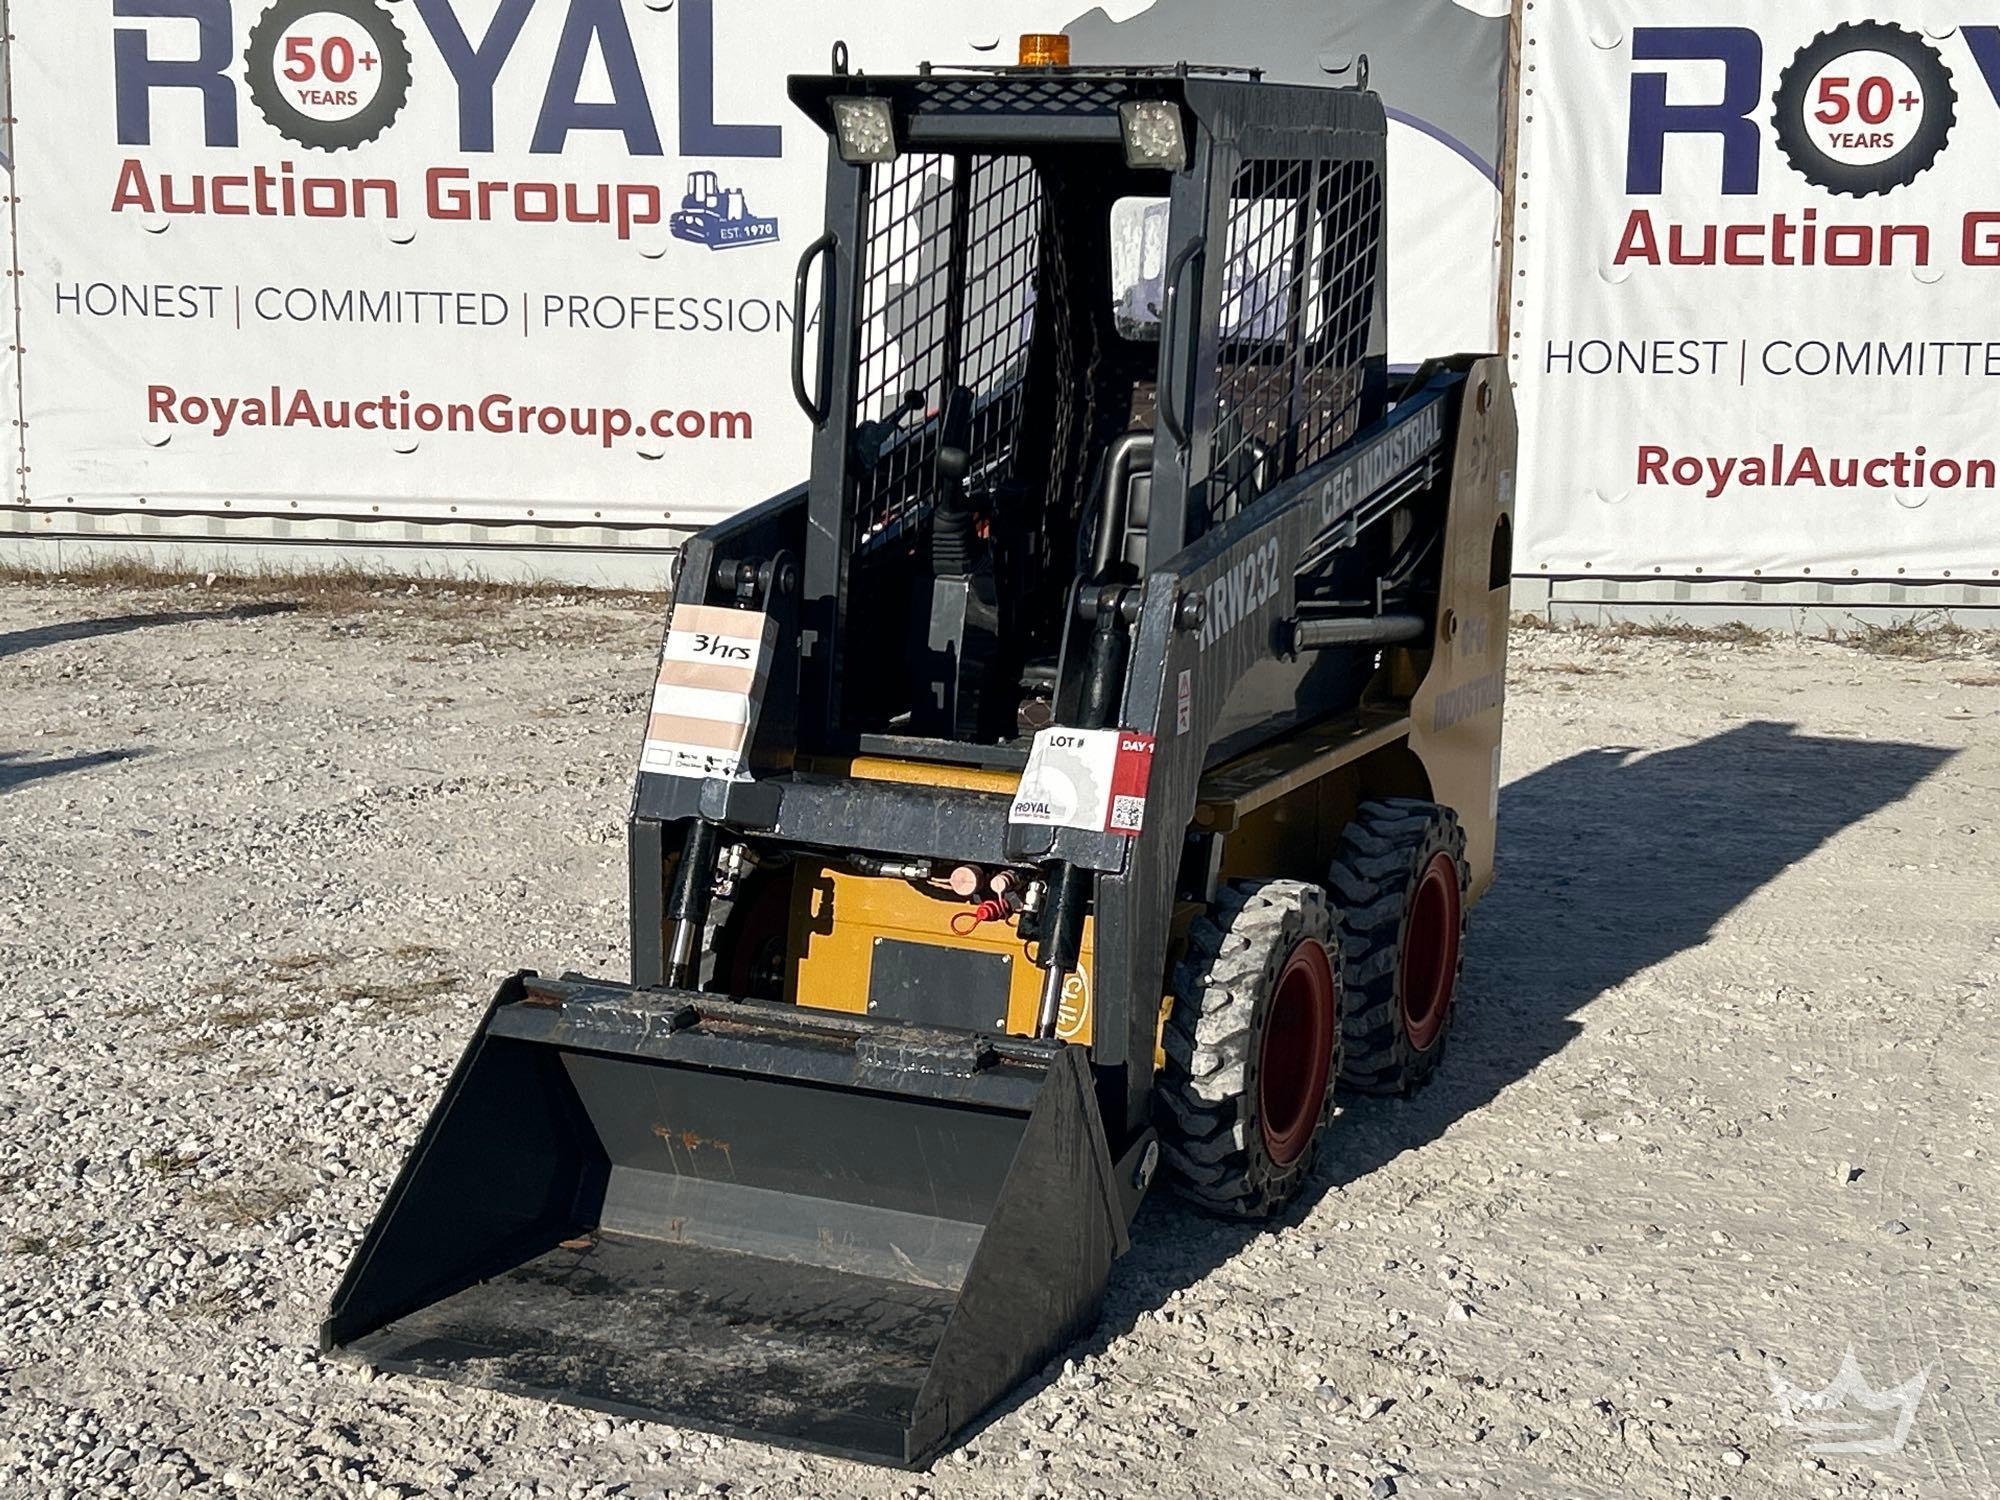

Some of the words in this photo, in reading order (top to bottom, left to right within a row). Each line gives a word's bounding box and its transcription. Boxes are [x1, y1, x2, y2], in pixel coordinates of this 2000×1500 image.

[113, 0, 782, 158] ROYAL
[283, 36, 379, 83] 50+
[298, 89, 358, 107] YEARS
[1814, 76, 1920, 125] 50+
[1829, 132, 1894, 149] YEARS
[111, 159, 399, 219] Auction
[426, 168, 661, 240] Group
[744, 223, 773, 236] 1970
[1613, 207, 1930, 266] Auction
[57, 283, 222, 318] HONEST
[256, 288, 509, 325] COMMITTED
[1547, 340, 1728, 375] HONEST
[148, 384, 753, 448] RoyalAuctionGroup.com
[1357, 404, 1442, 497] INDUSTRIAL
[1637, 444, 1996, 498] RoyalAuction
[1050, 736, 1076, 748] LOT
[1077, 738, 1085, 748] #
[1121, 740, 1147, 752] DAY
[1014, 802, 1051, 814] ROYAL
